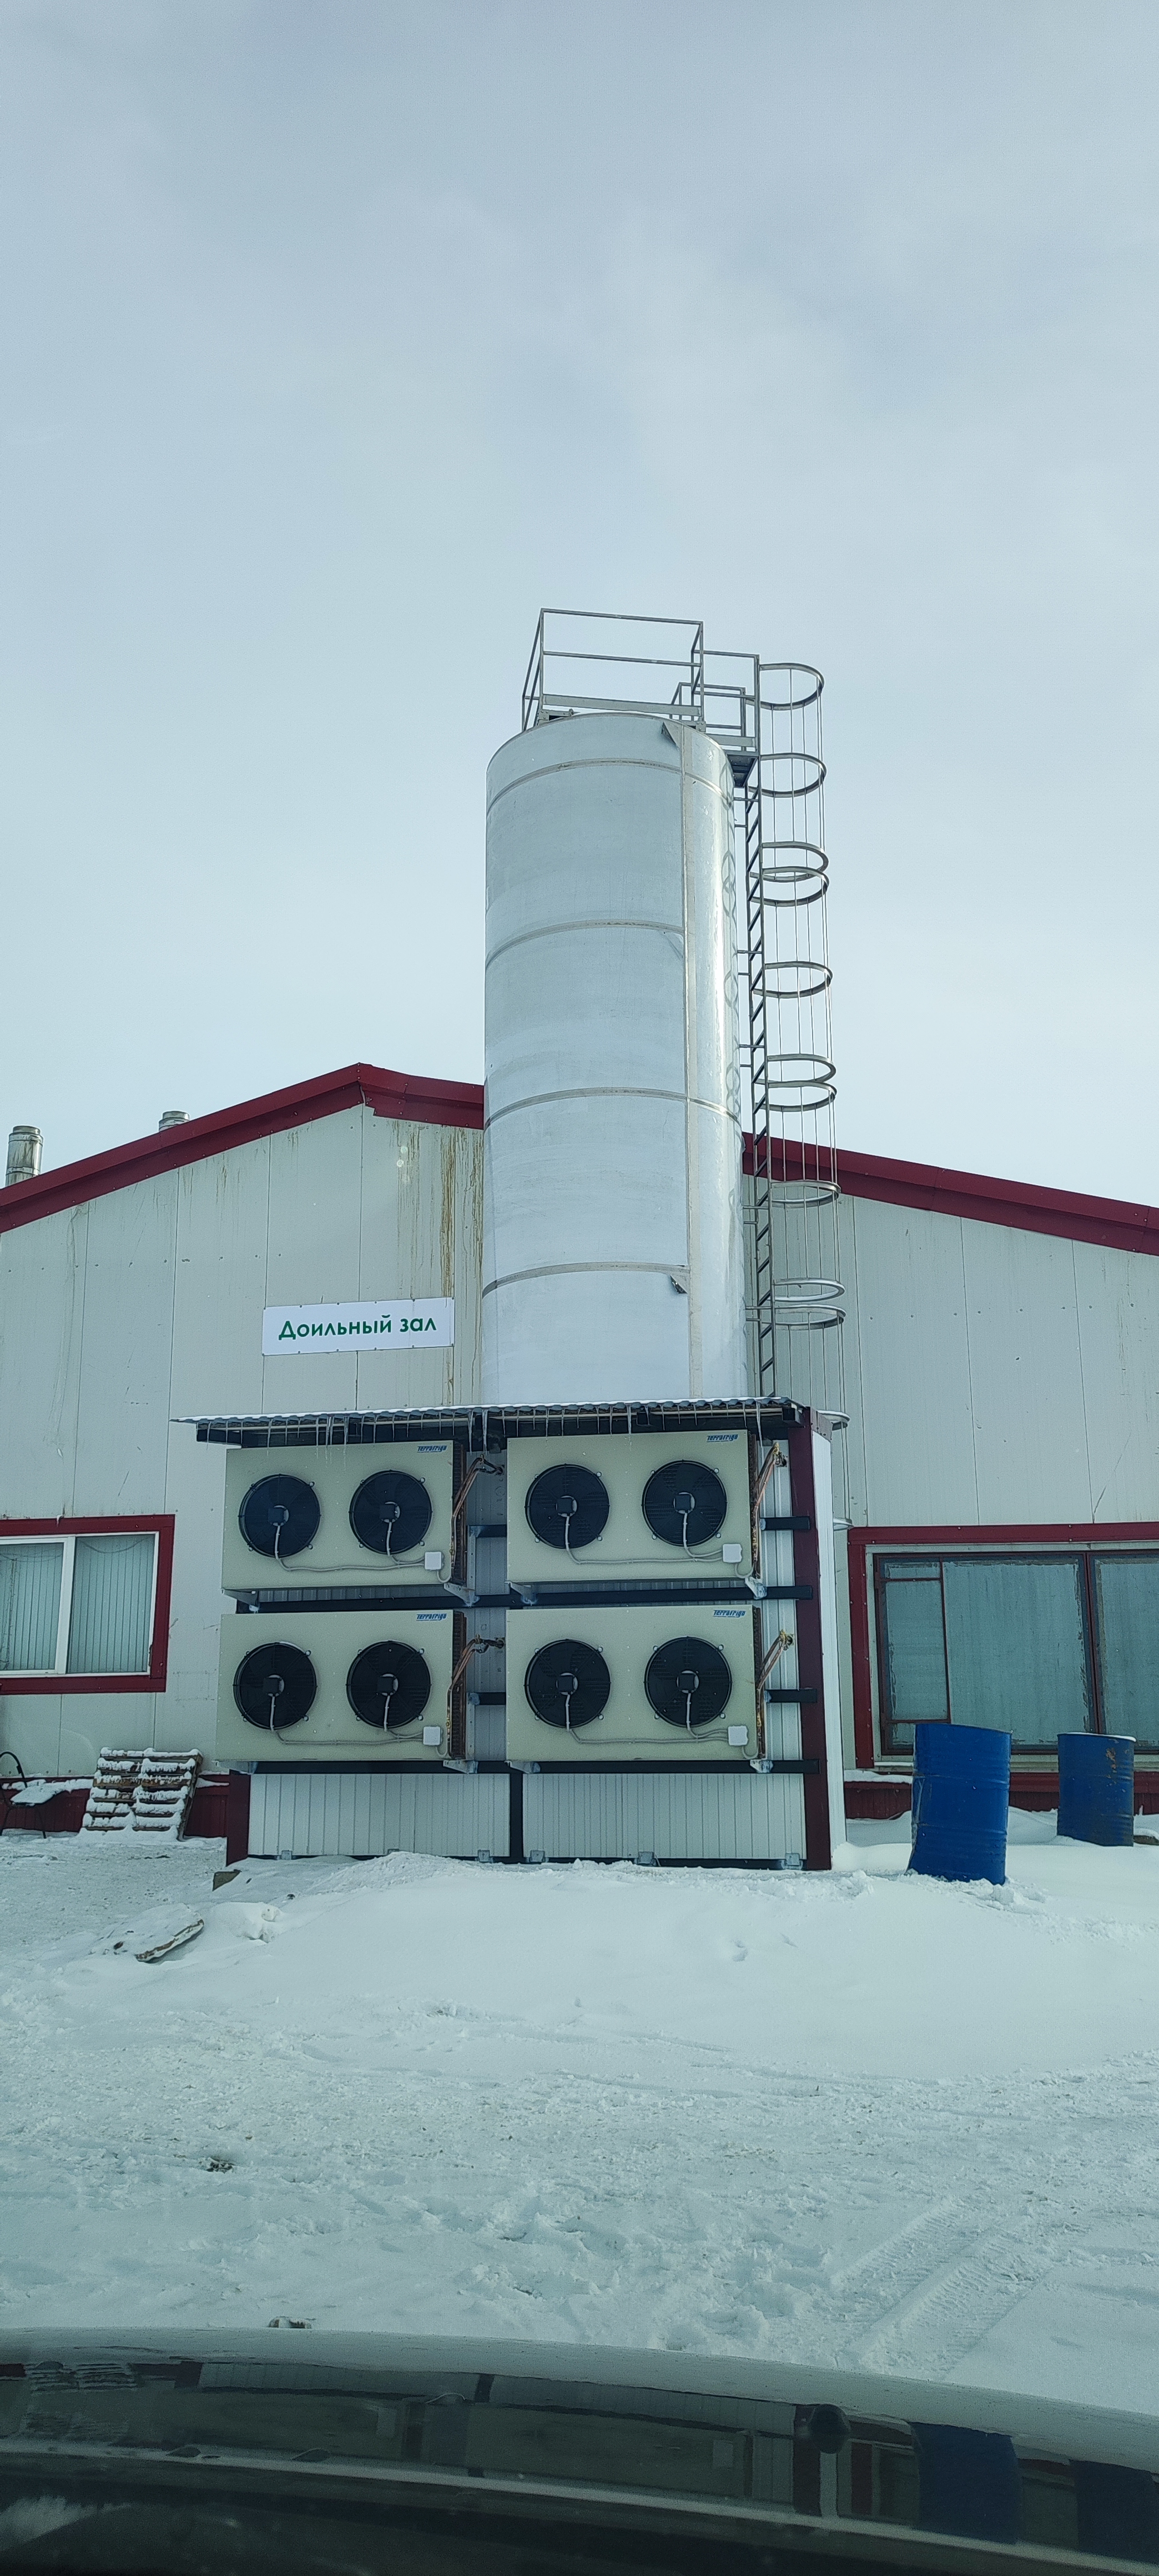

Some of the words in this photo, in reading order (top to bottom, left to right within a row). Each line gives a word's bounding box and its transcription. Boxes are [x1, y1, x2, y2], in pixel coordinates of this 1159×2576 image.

[278, 1314, 392, 1341] Доильный
[399, 1318, 437, 1332] зал
[707, 1434, 738, 1442] Terrafrigo
